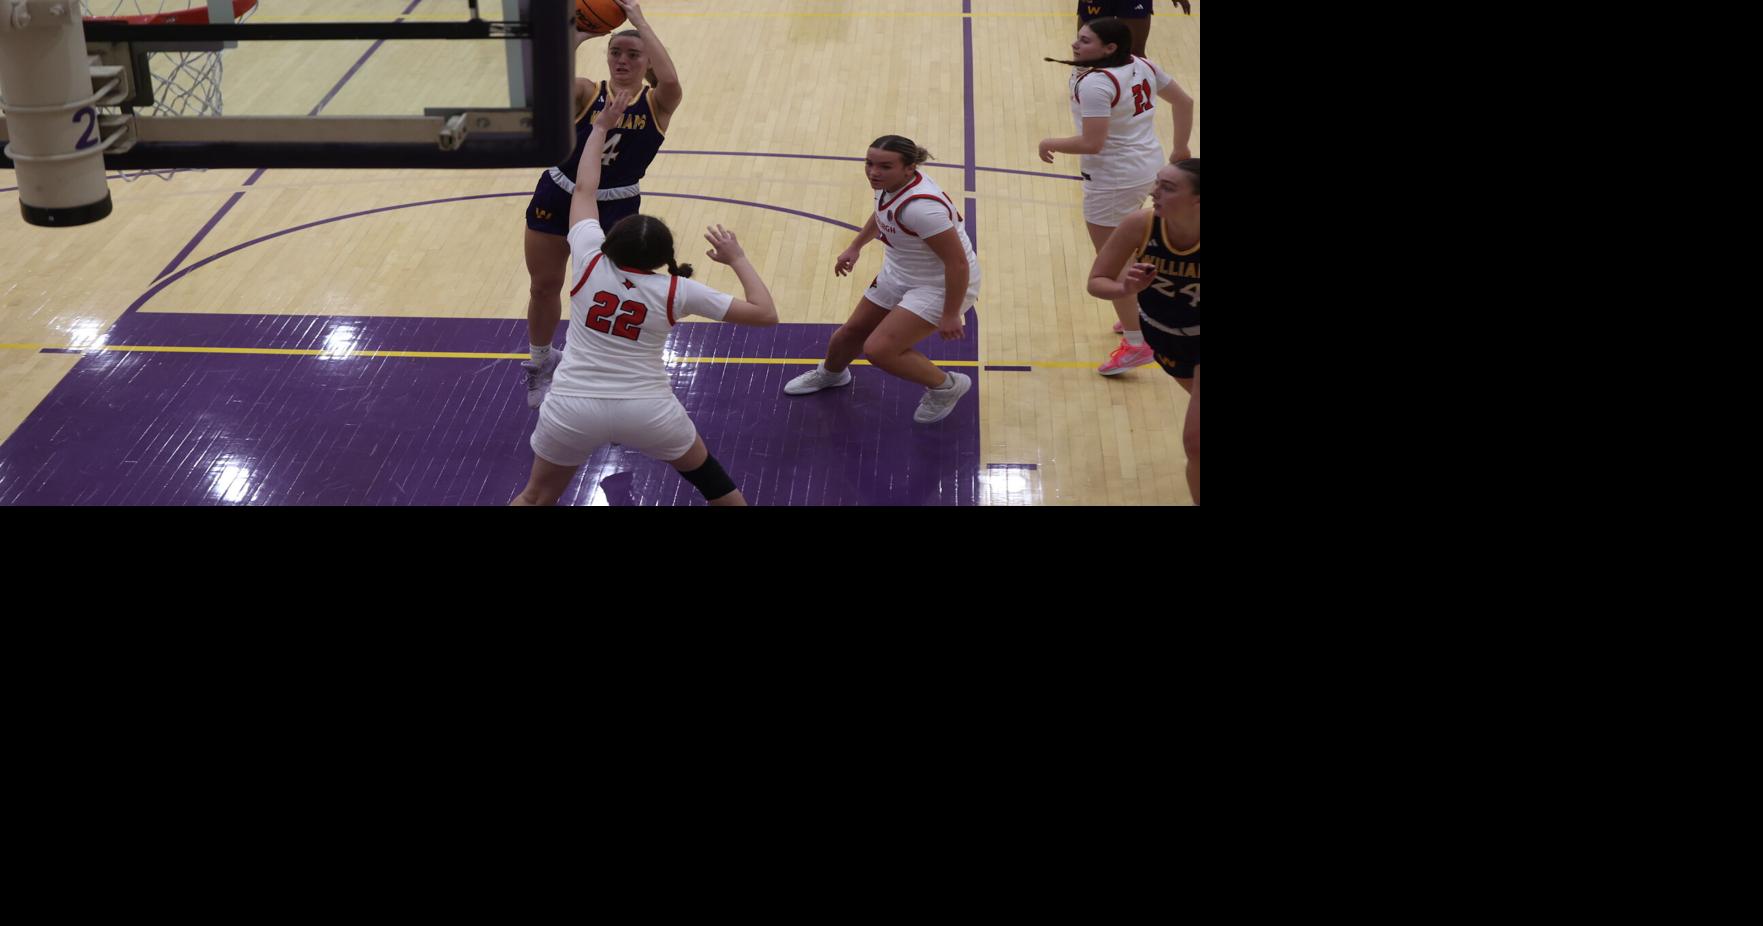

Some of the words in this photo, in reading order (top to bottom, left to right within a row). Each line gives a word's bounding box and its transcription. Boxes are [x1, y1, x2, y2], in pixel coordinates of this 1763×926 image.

[1131, 78, 1154, 117] 21
[72, 105, 99, 151] 2
[600, 133, 622, 166] 4
[1151, 275, 1200, 307] 24
[585, 290, 649, 342] 22
